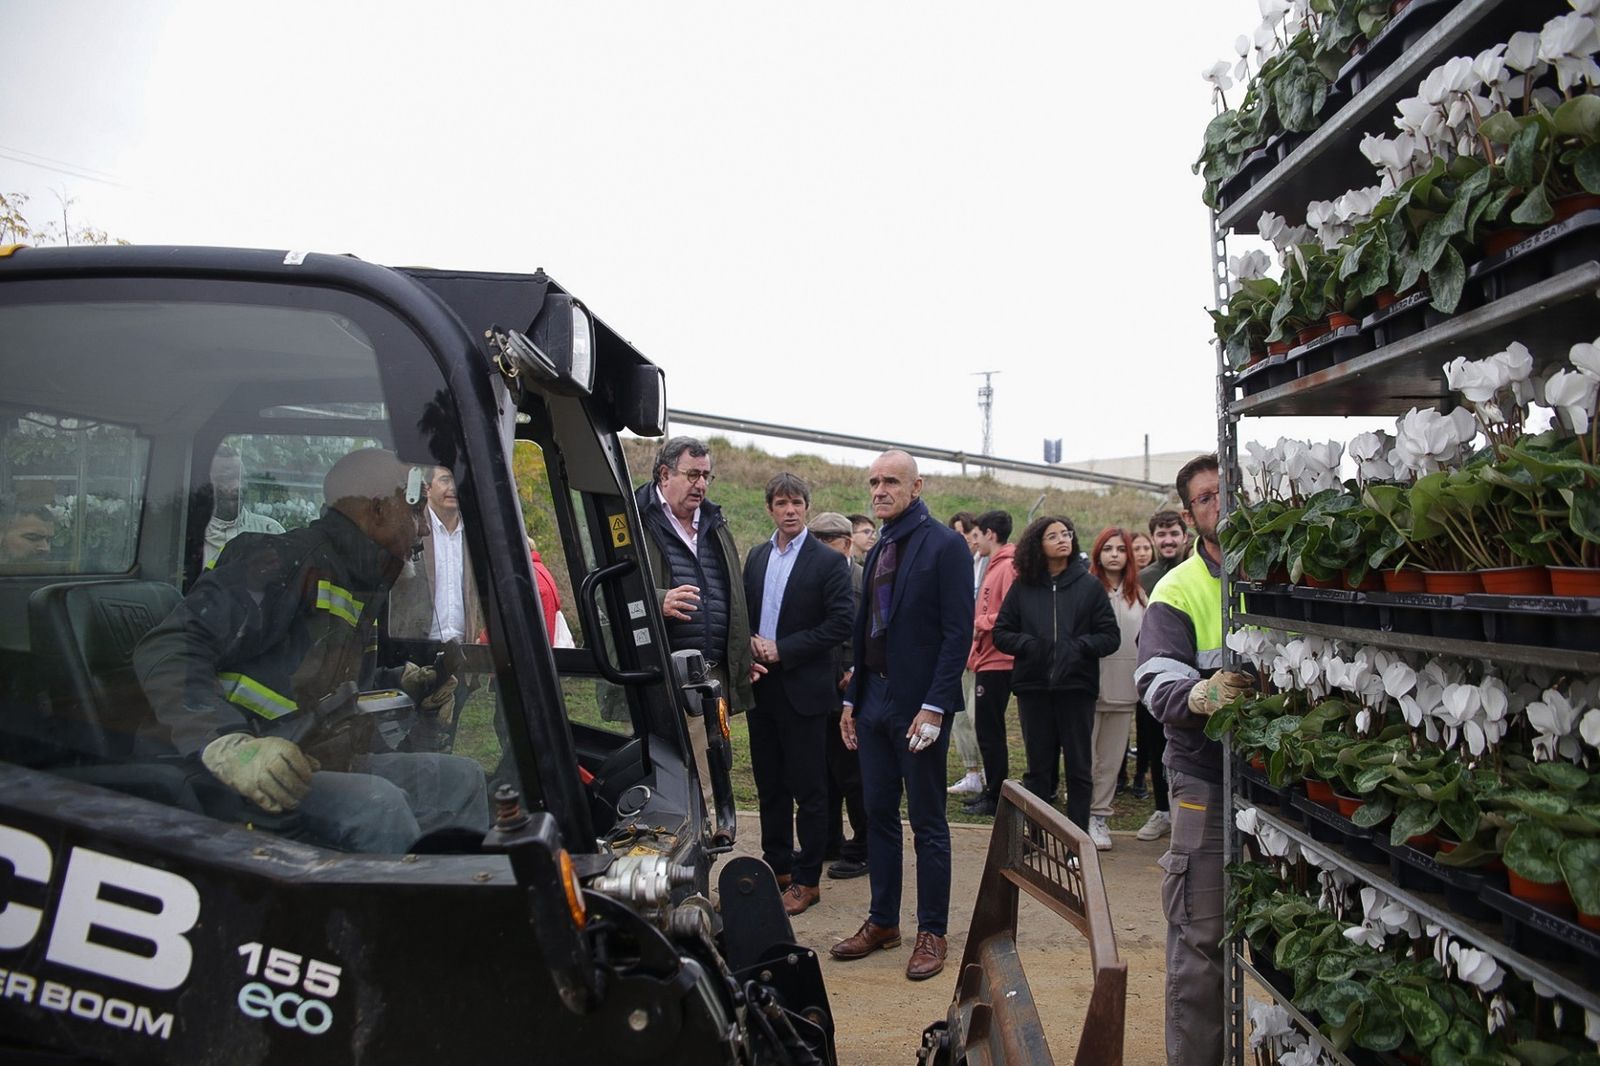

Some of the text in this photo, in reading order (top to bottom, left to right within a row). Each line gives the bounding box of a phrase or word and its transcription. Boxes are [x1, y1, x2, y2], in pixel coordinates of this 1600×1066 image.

[238, 941, 342, 998] 155
[39, 980, 174, 1039] BOOM
[238, 981, 333, 1035] eco
